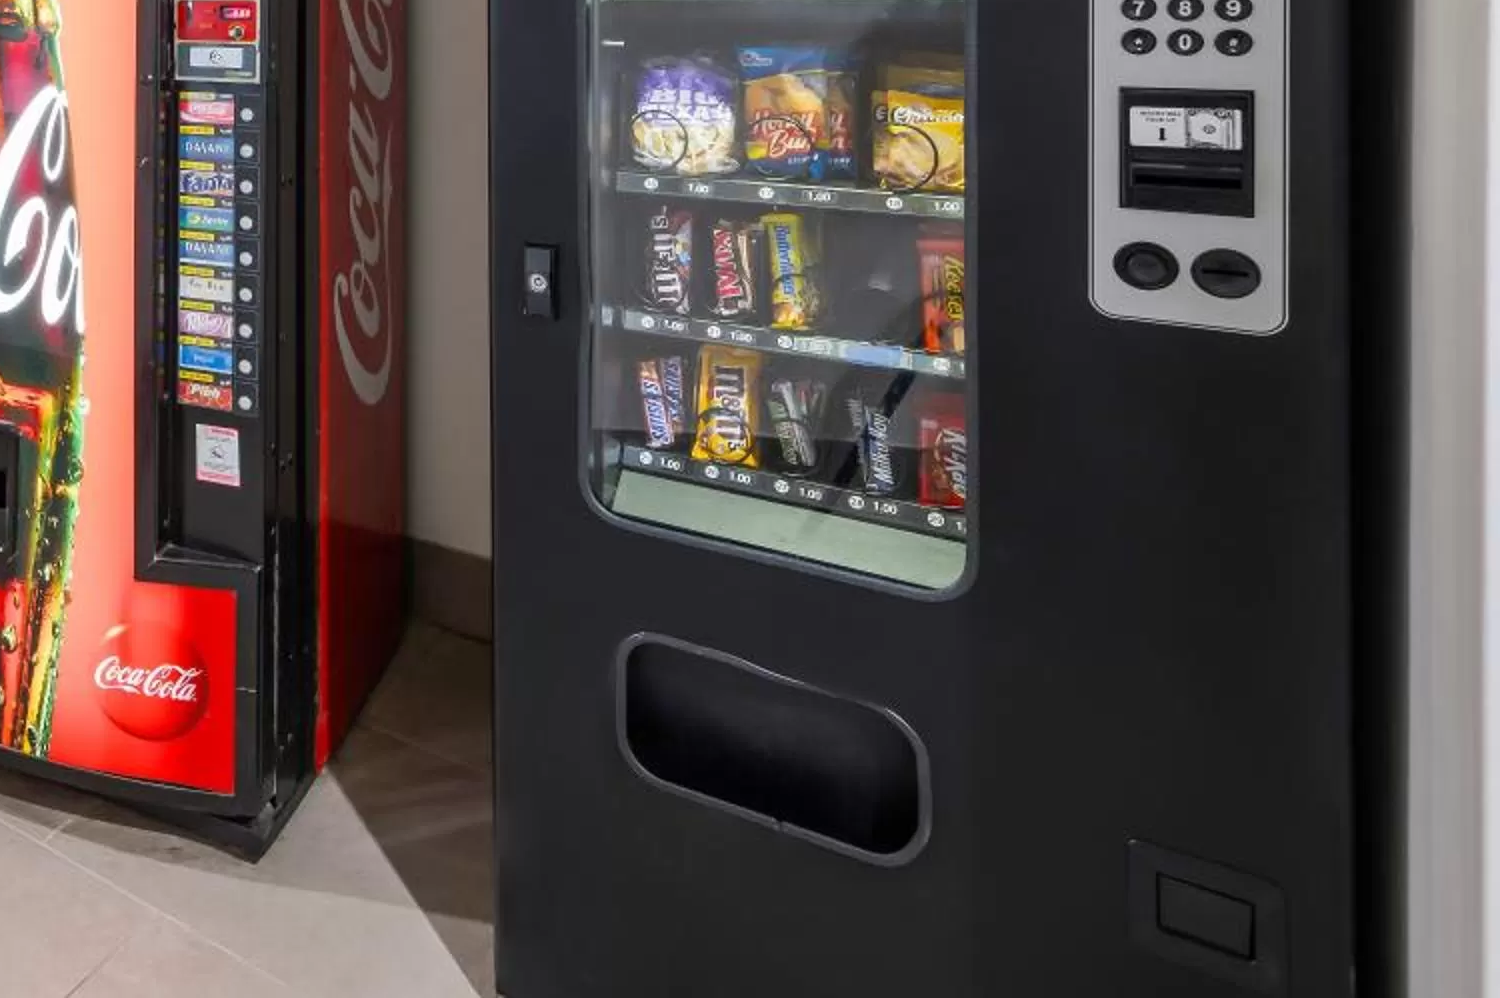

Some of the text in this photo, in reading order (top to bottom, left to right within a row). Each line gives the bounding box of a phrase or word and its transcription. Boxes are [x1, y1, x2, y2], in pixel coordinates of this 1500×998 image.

[1132, 0, 1242, 17] 7 8 9
[1178, 34, 1193, 50] 0
[660, 457, 681, 471] 1.00
[729, 471, 751, 485] 1.00
[799, 487, 823, 501] 1.00
[873, 501, 898, 515] 1.00
[94, 655, 203, 701] Coca-Cola
